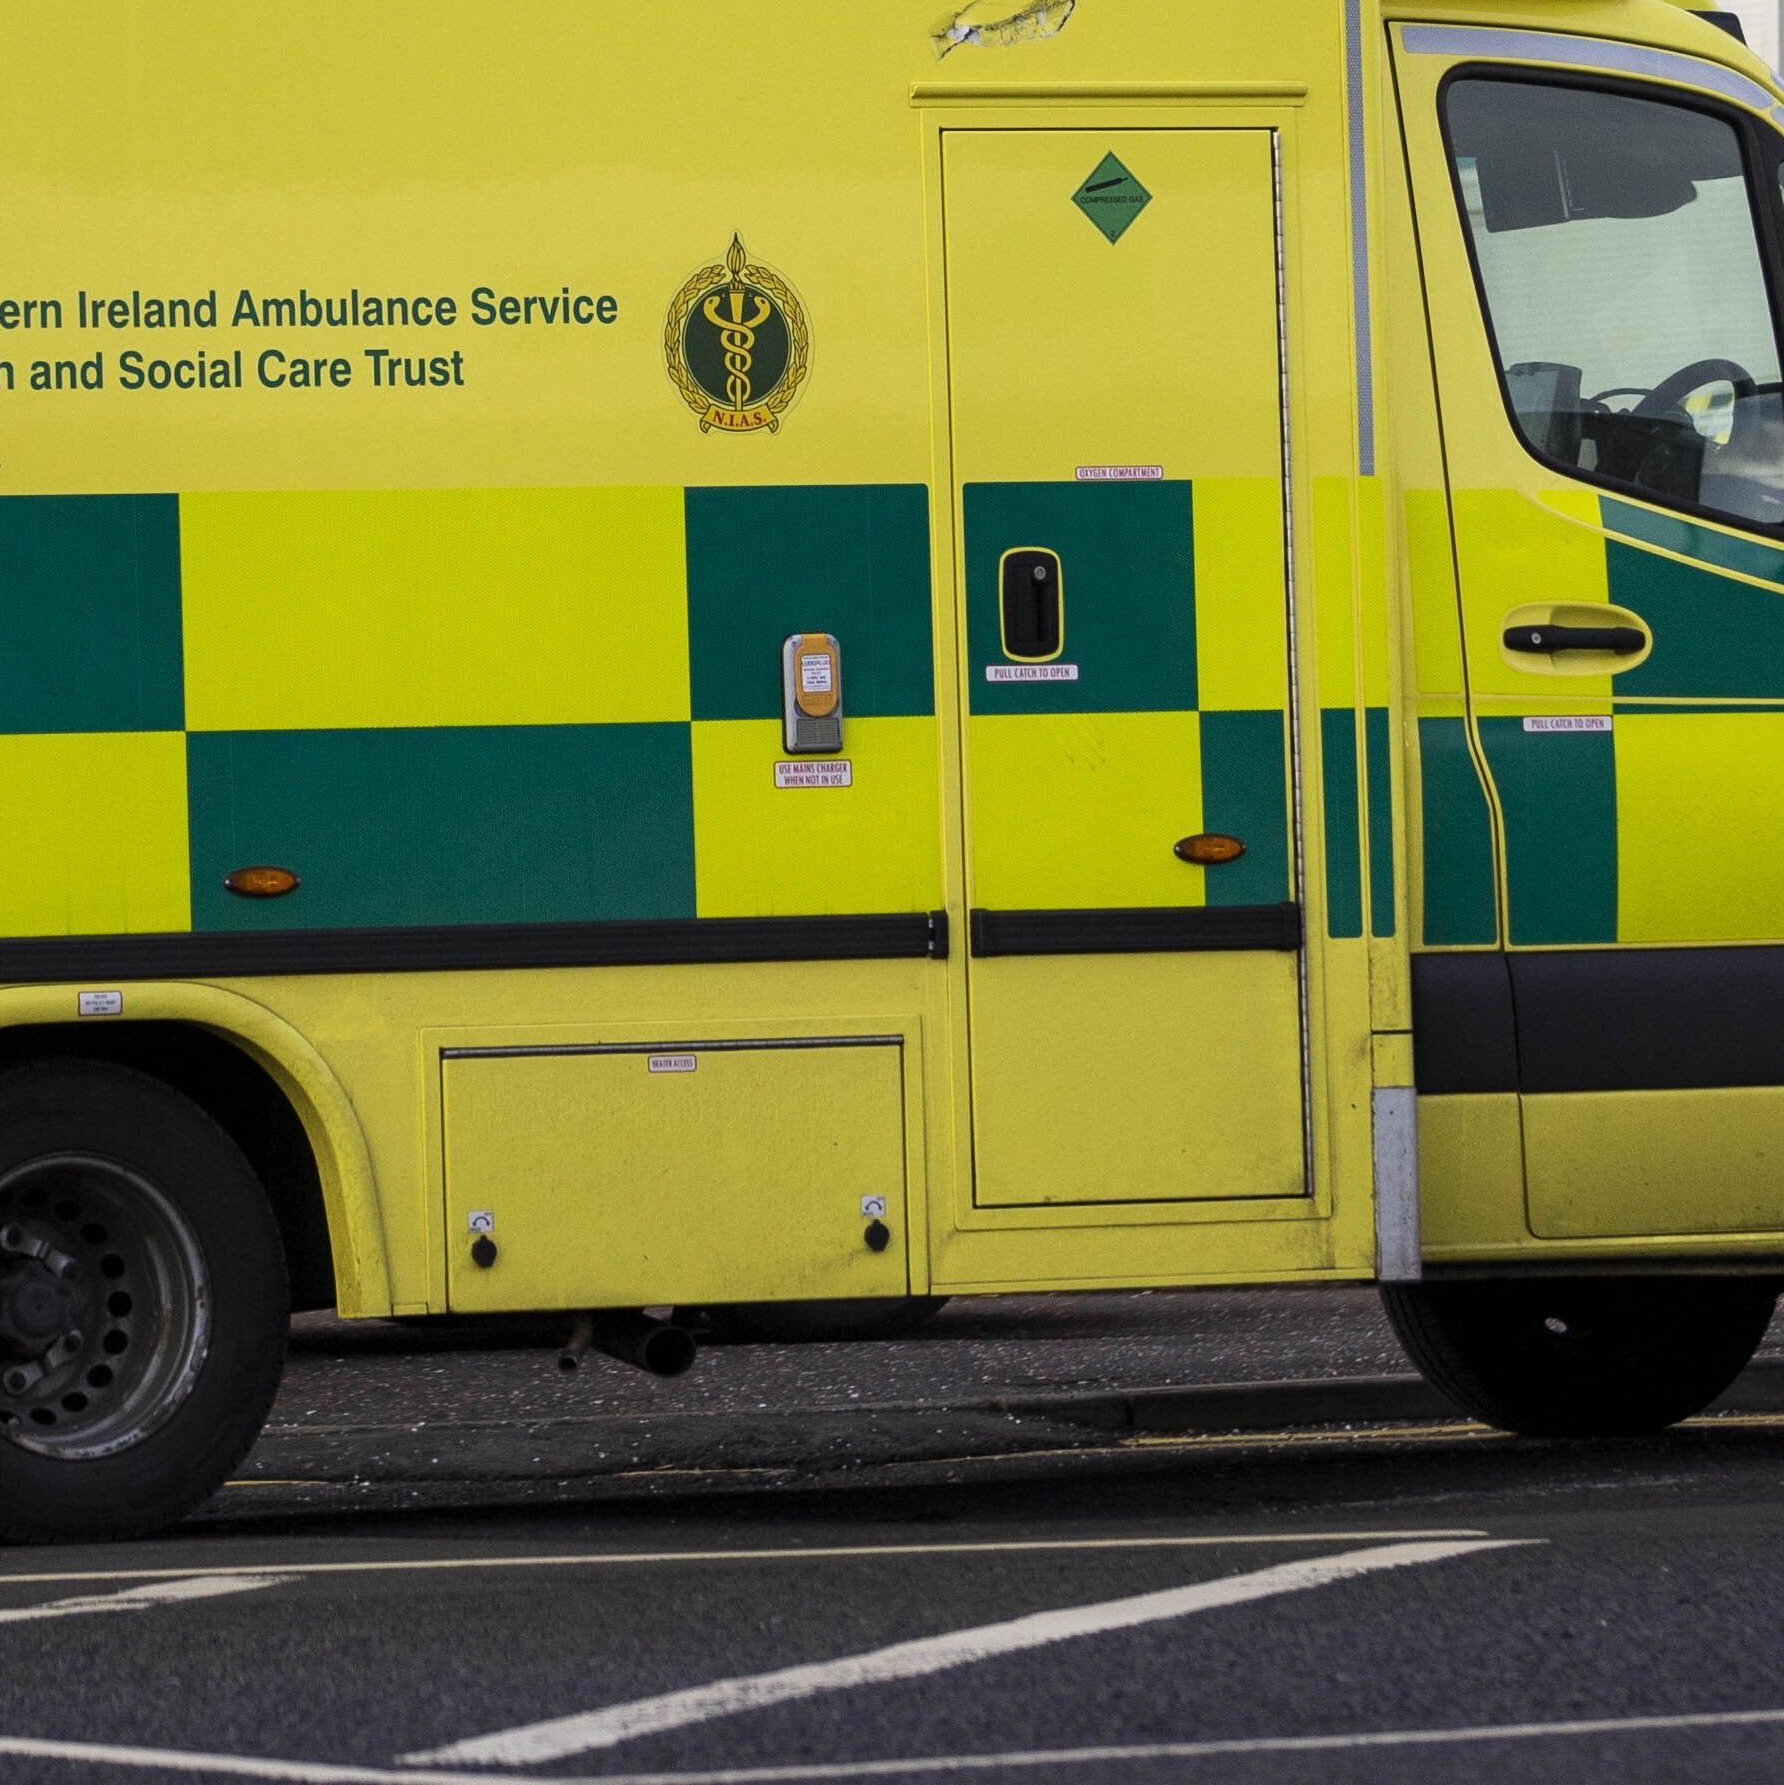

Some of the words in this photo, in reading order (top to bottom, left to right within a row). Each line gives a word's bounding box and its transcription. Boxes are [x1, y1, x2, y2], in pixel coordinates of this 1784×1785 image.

[78, 290, 217, 329] Ireland
[231, 288, 457, 327] Ambulance
[470, 286, 618, 325] Service
[29, 352, 104, 390] and
[118, 349, 242, 389] Social
[257, 348, 352, 388] Care
[364, 348, 465, 387] Trust
[712, 411, 767, 427] N.I.A.S.
[1079, 468, 1107, 478] OXYGEN
[1109, 467, 1159, 477] COMPARTMENT
[995, 668, 1011, 679] PULL
[1015, 667, 1036, 679] CATCH
[1039, 667, 1048, 678] TO
[1050, 667, 1070, 678] OPEN
[1531, 719, 1549, 729] PULL
[1550, 718, 1573, 729] CATCH
[1574, 718, 1584, 728] TO
[1585, 718, 1604, 729] OPEN
[779, 764, 792, 775] USE
[793, 763, 815, 774] MAINS
[816, 762, 847, 774] CHARGER
[784, 775, 804, 785] WHEN
[805, 775, 820, 785] NOT
[821, 774, 829, 785] IN
[830, 774, 843, 784] USE
[674, 1058, 693, 1068] ACCESS
